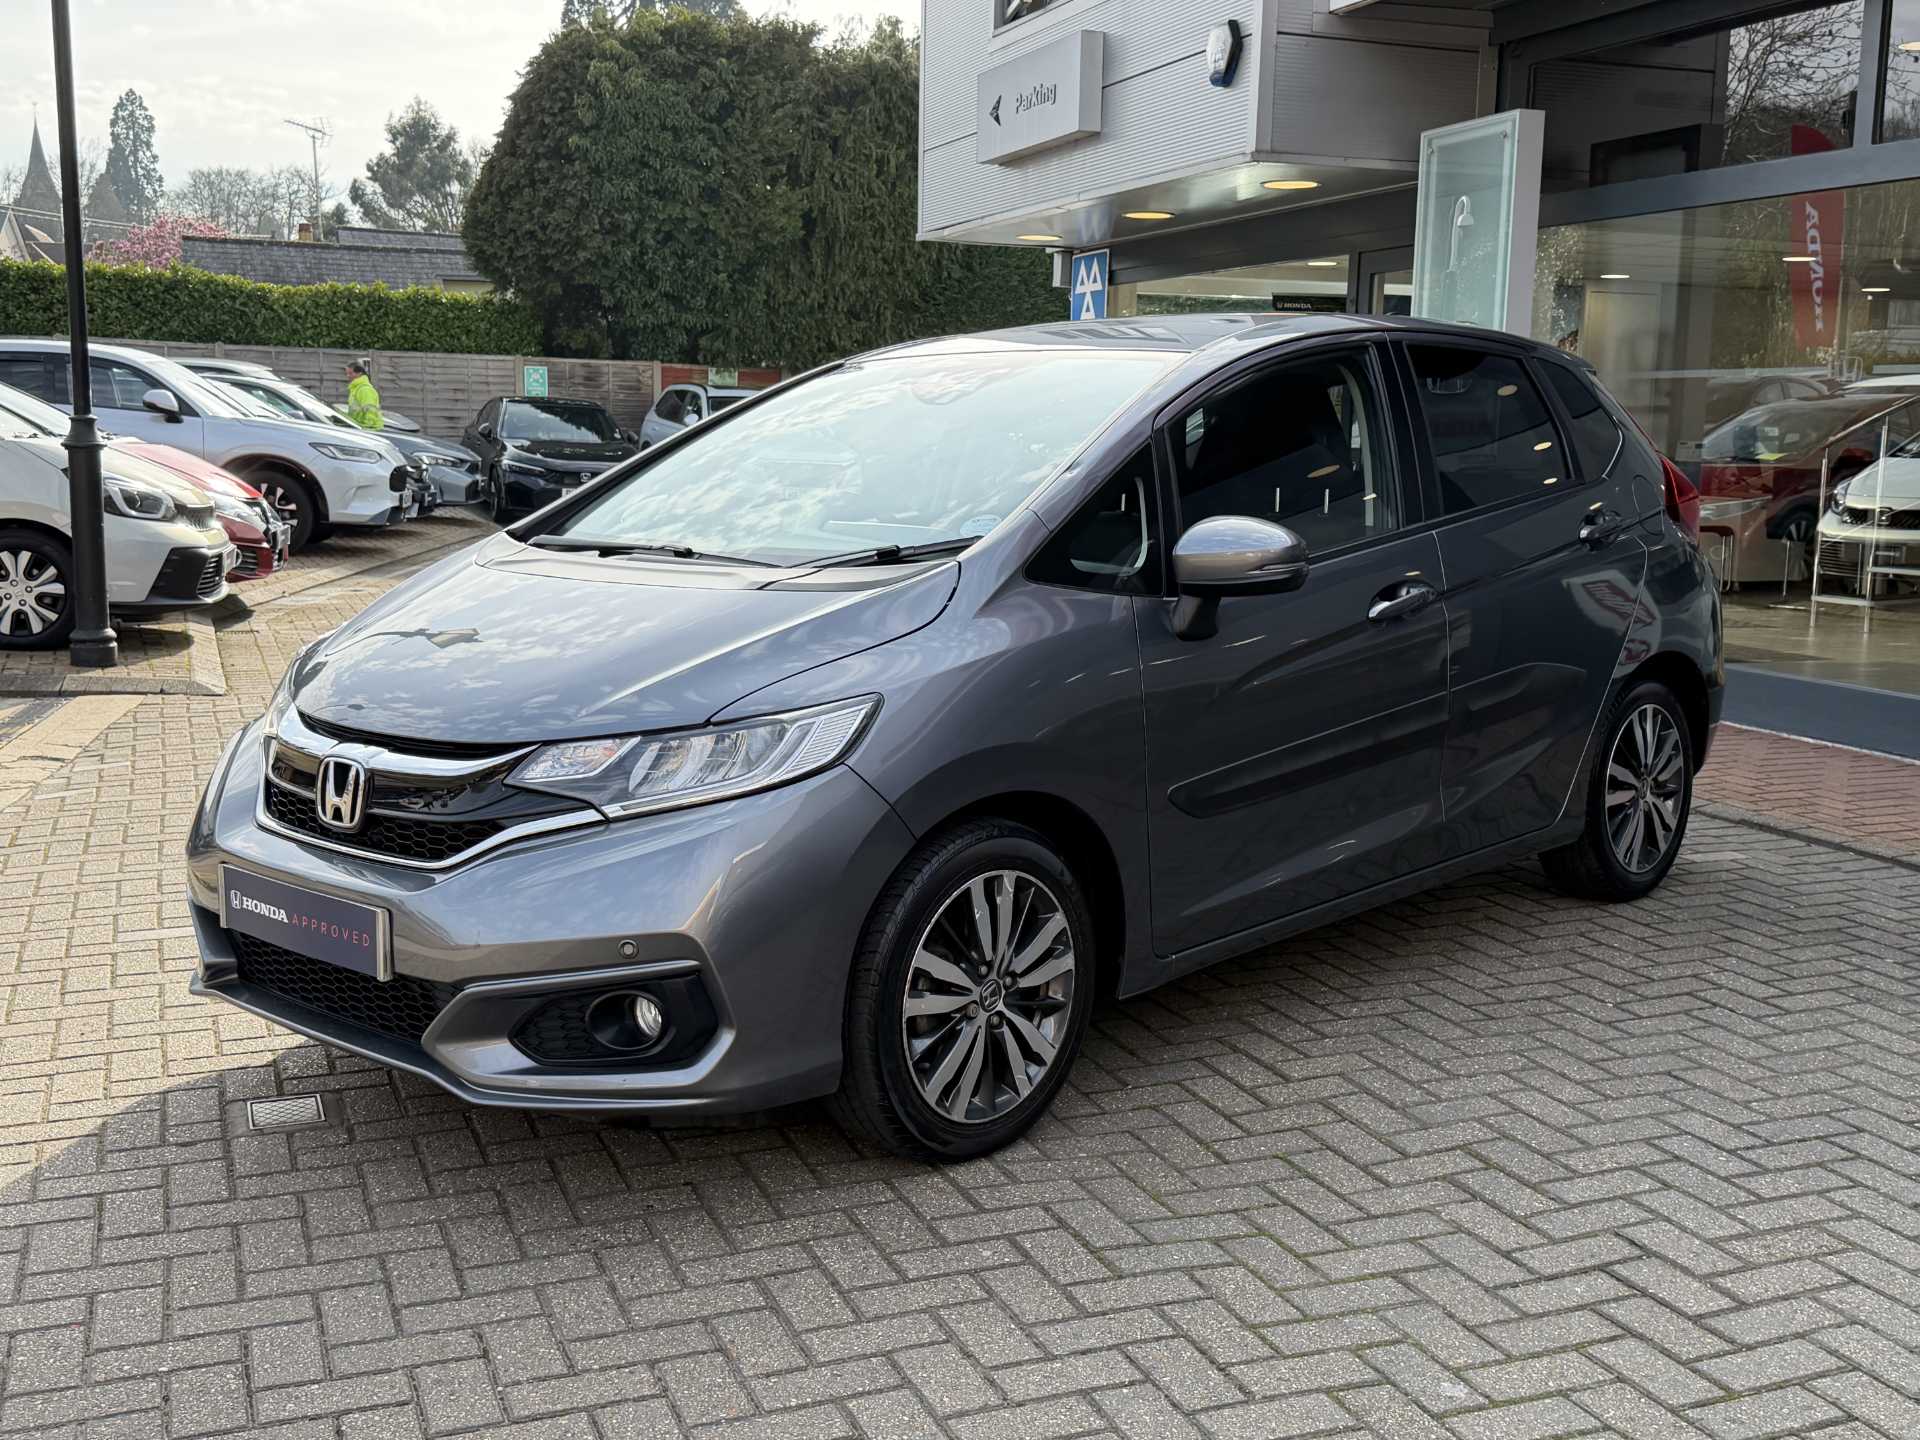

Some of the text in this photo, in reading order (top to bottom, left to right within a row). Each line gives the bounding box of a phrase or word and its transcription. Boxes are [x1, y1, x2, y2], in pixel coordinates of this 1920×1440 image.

[1016, 83, 1056, 114] Parking
[242, 896, 288, 923] HONDA
[292, 914, 370, 946] APPROVED
